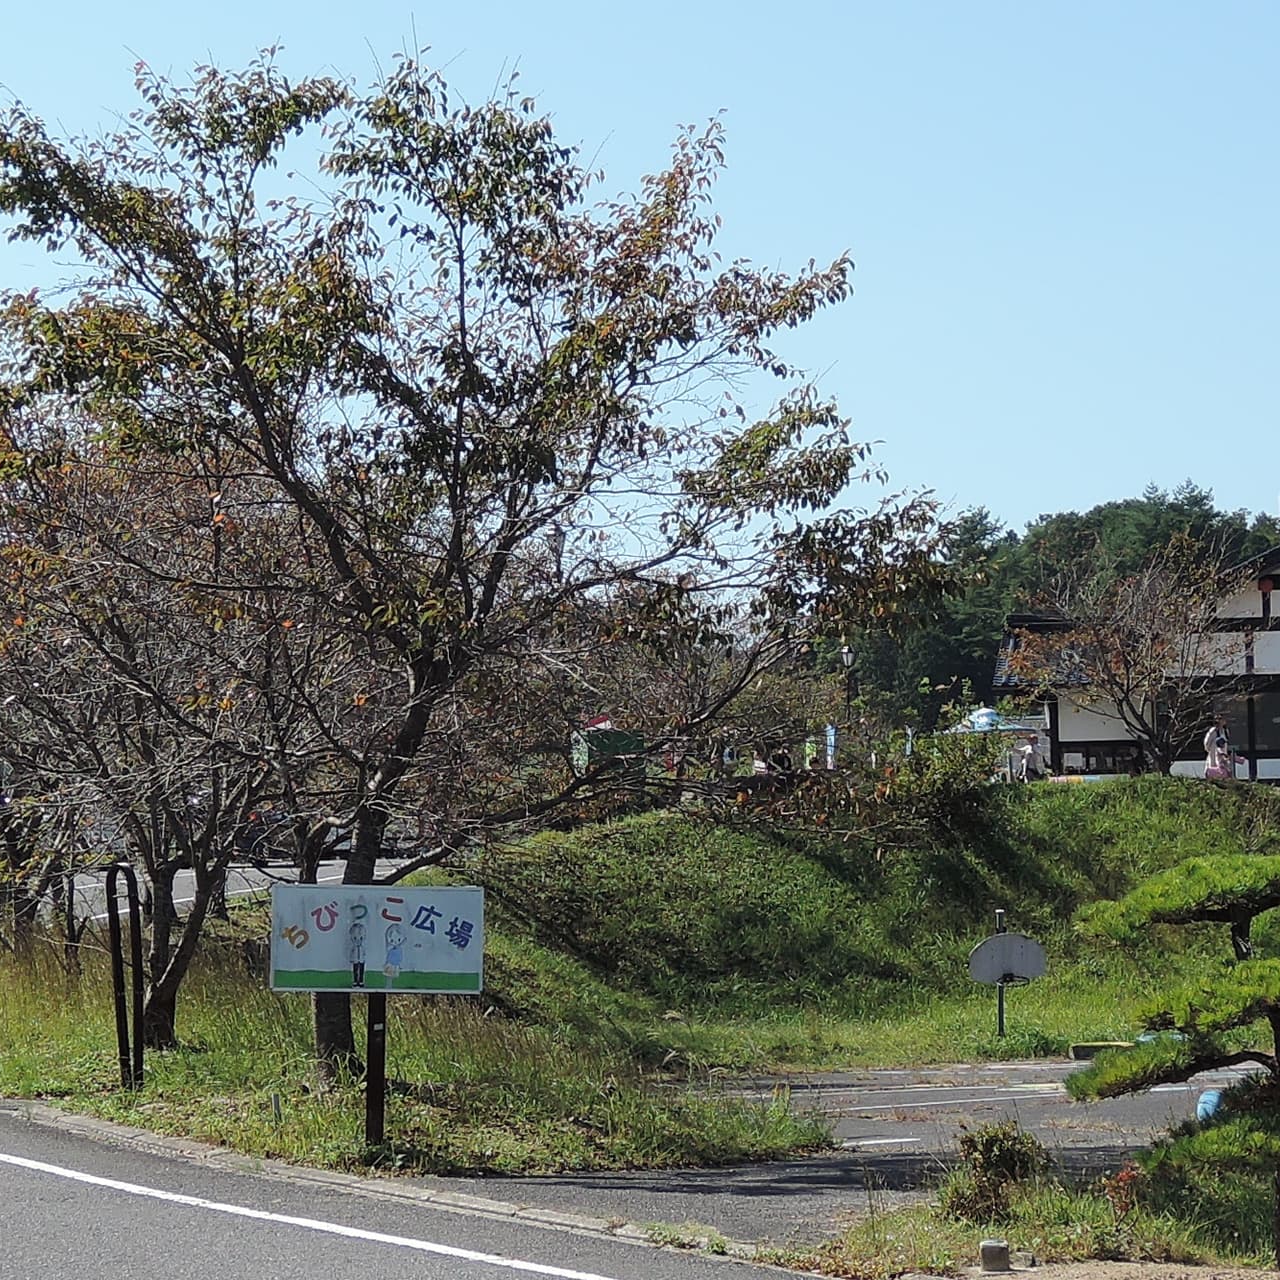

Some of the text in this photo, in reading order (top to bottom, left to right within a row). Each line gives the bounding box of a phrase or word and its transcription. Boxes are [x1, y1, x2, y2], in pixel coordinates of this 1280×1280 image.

[281, 896, 475, 951] ちびっこ広場
